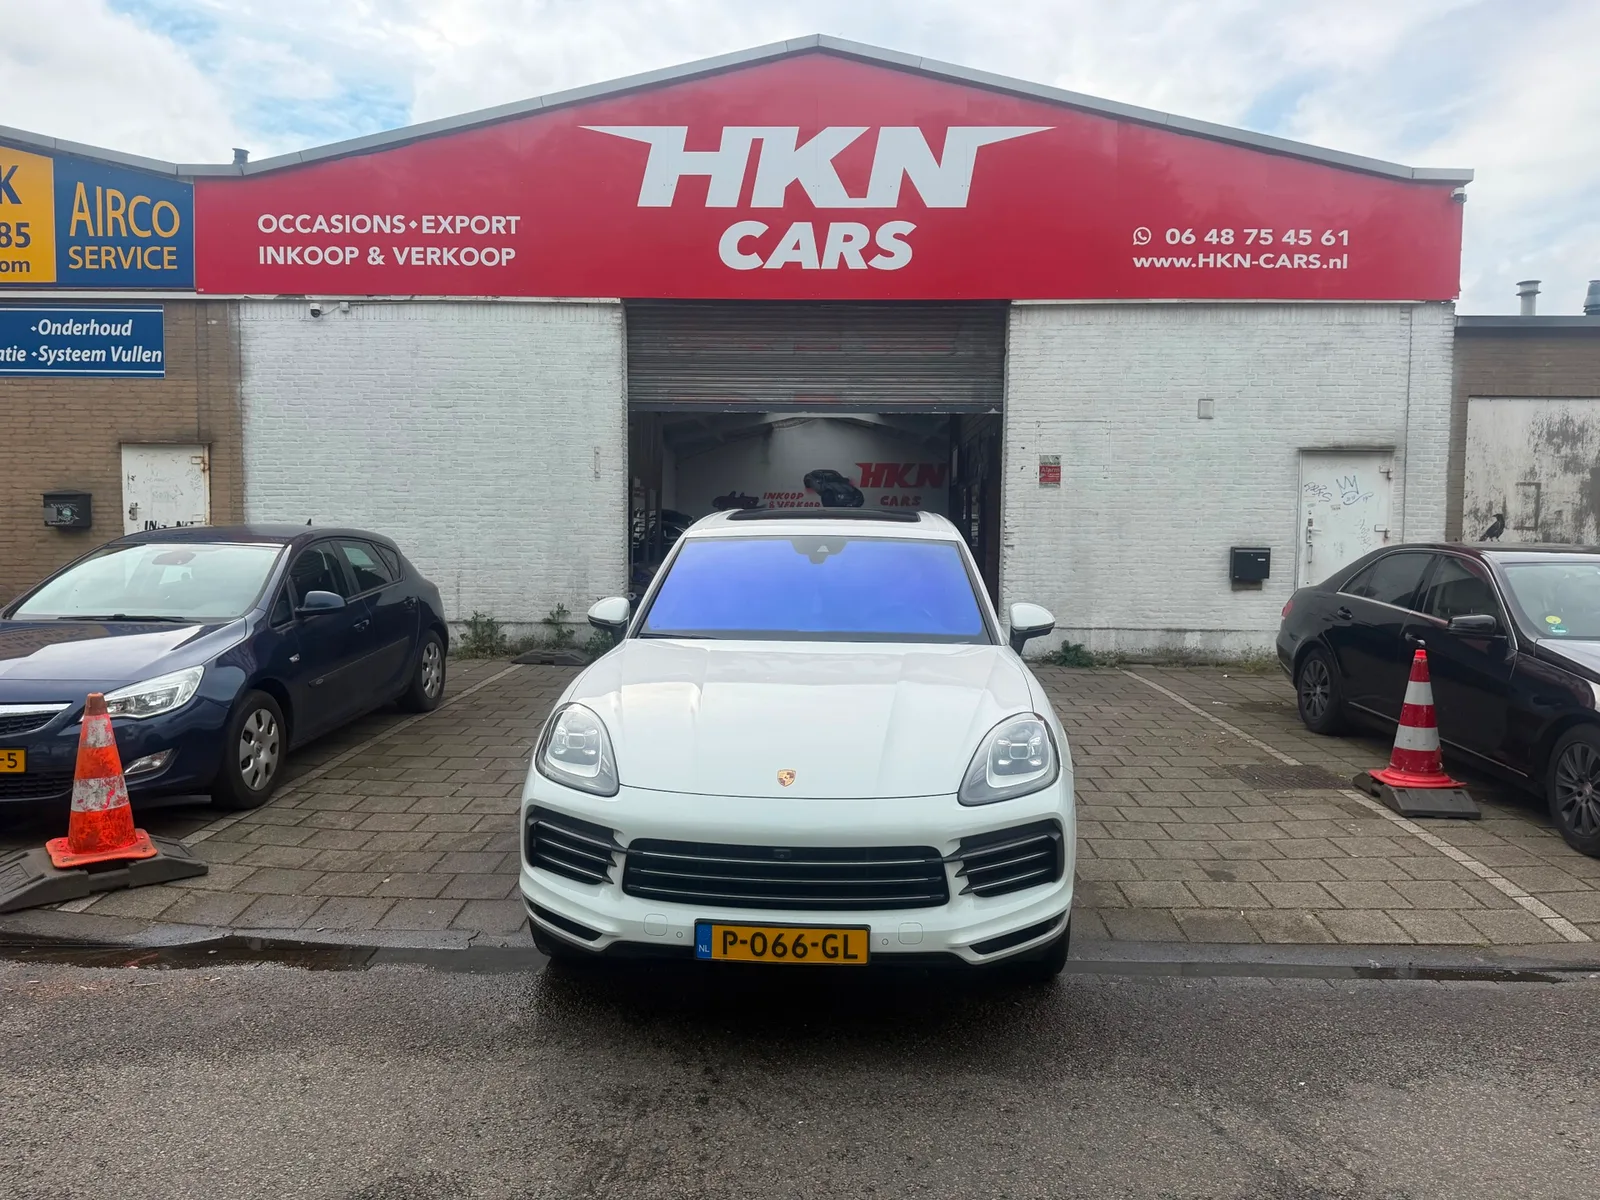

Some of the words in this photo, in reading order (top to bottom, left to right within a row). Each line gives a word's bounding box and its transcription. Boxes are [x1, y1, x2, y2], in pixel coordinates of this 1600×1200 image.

[577, 125, 1058, 208] HKN
[69, 181, 181, 238] AIRCO
[0, 222, 31, 248] 85
[257, 213, 406, 234] OCCASIONS
[422, 215, 521, 235] EXPORT
[718, 220, 918, 271] CARS
[1165, 228, 1197, 245] 06
[1203, 228, 1235, 245] 48
[1243, 228, 1274, 246] 75
[1281, 229, 1313, 246] 45
[1320, 229, 1350, 246] 61
[68, 246, 179, 270] SERVICE
[258, 246, 360, 265] INKOOP
[366, 246, 386, 266] &
[392, 247, 516, 267] VERKOOP
[1132, 253, 1349, 269] www.HKN-CARS.nl
[37, 318, 133, 337] Onderhoud
[38, 345, 107, 367] Systeem
[110, 346, 163, 364] Vullen
[855, 462, 949, 488] HKN
[763, 492, 805, 500] INKOOP
[880, 495, 922, 507] CARS
[698, 944, 710, 953] NL
[722, 930, 859, 960] P-066-GL
